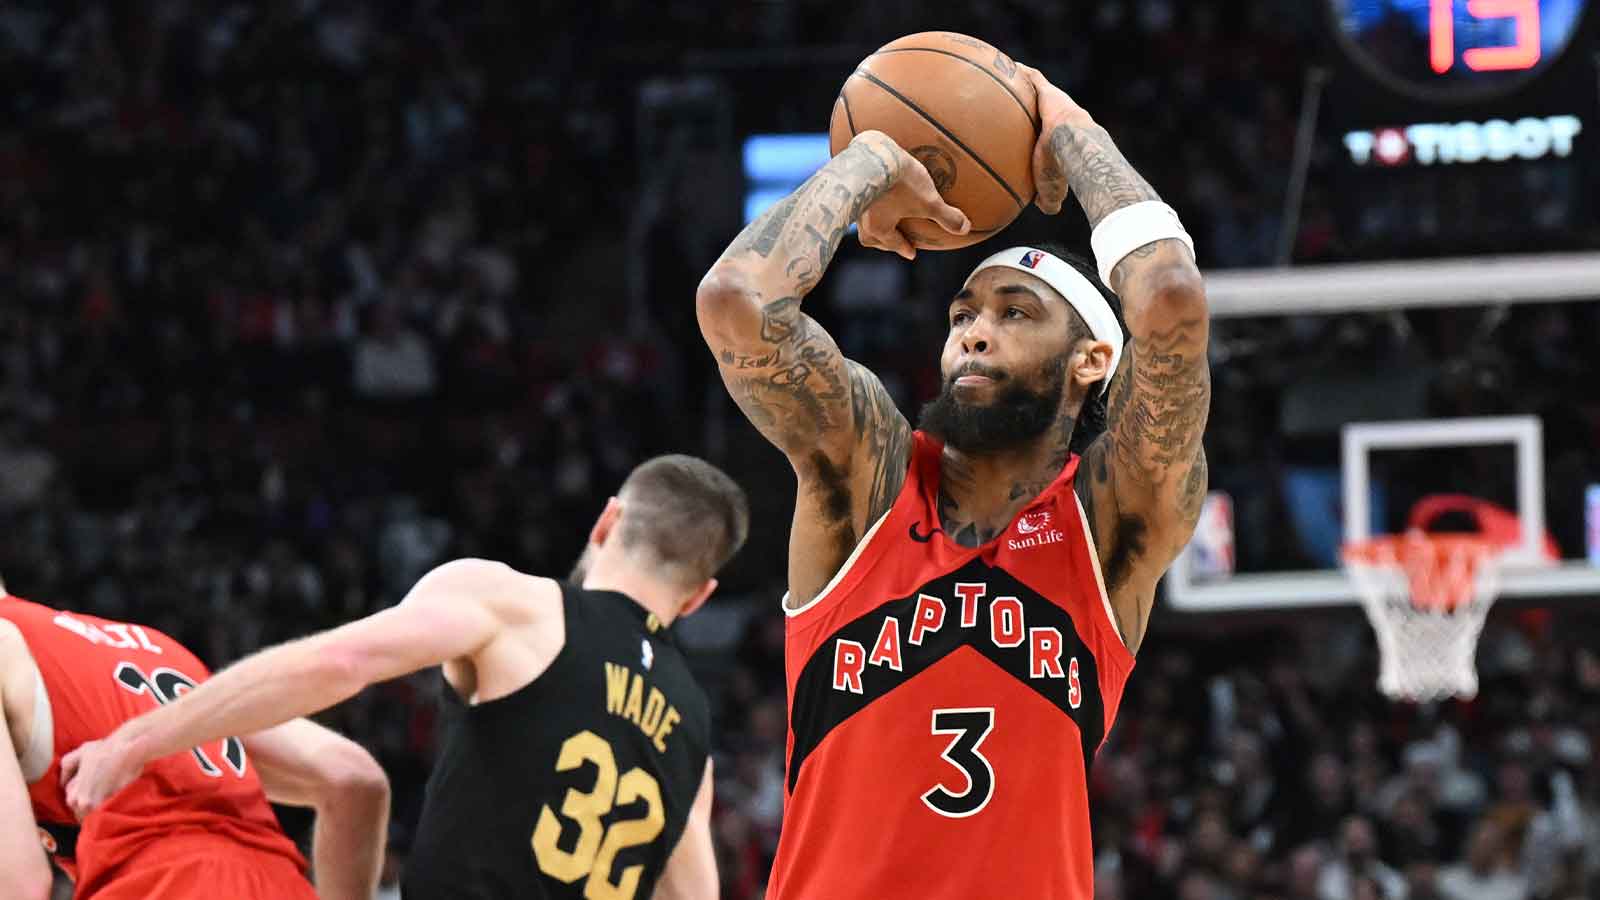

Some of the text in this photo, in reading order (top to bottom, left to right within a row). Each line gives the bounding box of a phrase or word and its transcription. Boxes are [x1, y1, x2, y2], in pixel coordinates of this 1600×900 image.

[1008, 529, 1063, 550] Sun Life
[833, 583, 1081, 708] RAPTORS
[605, 661, 680, 753] WADE
[920, 707, 995, 818] 3
[531, 730, 665, 899] 32
